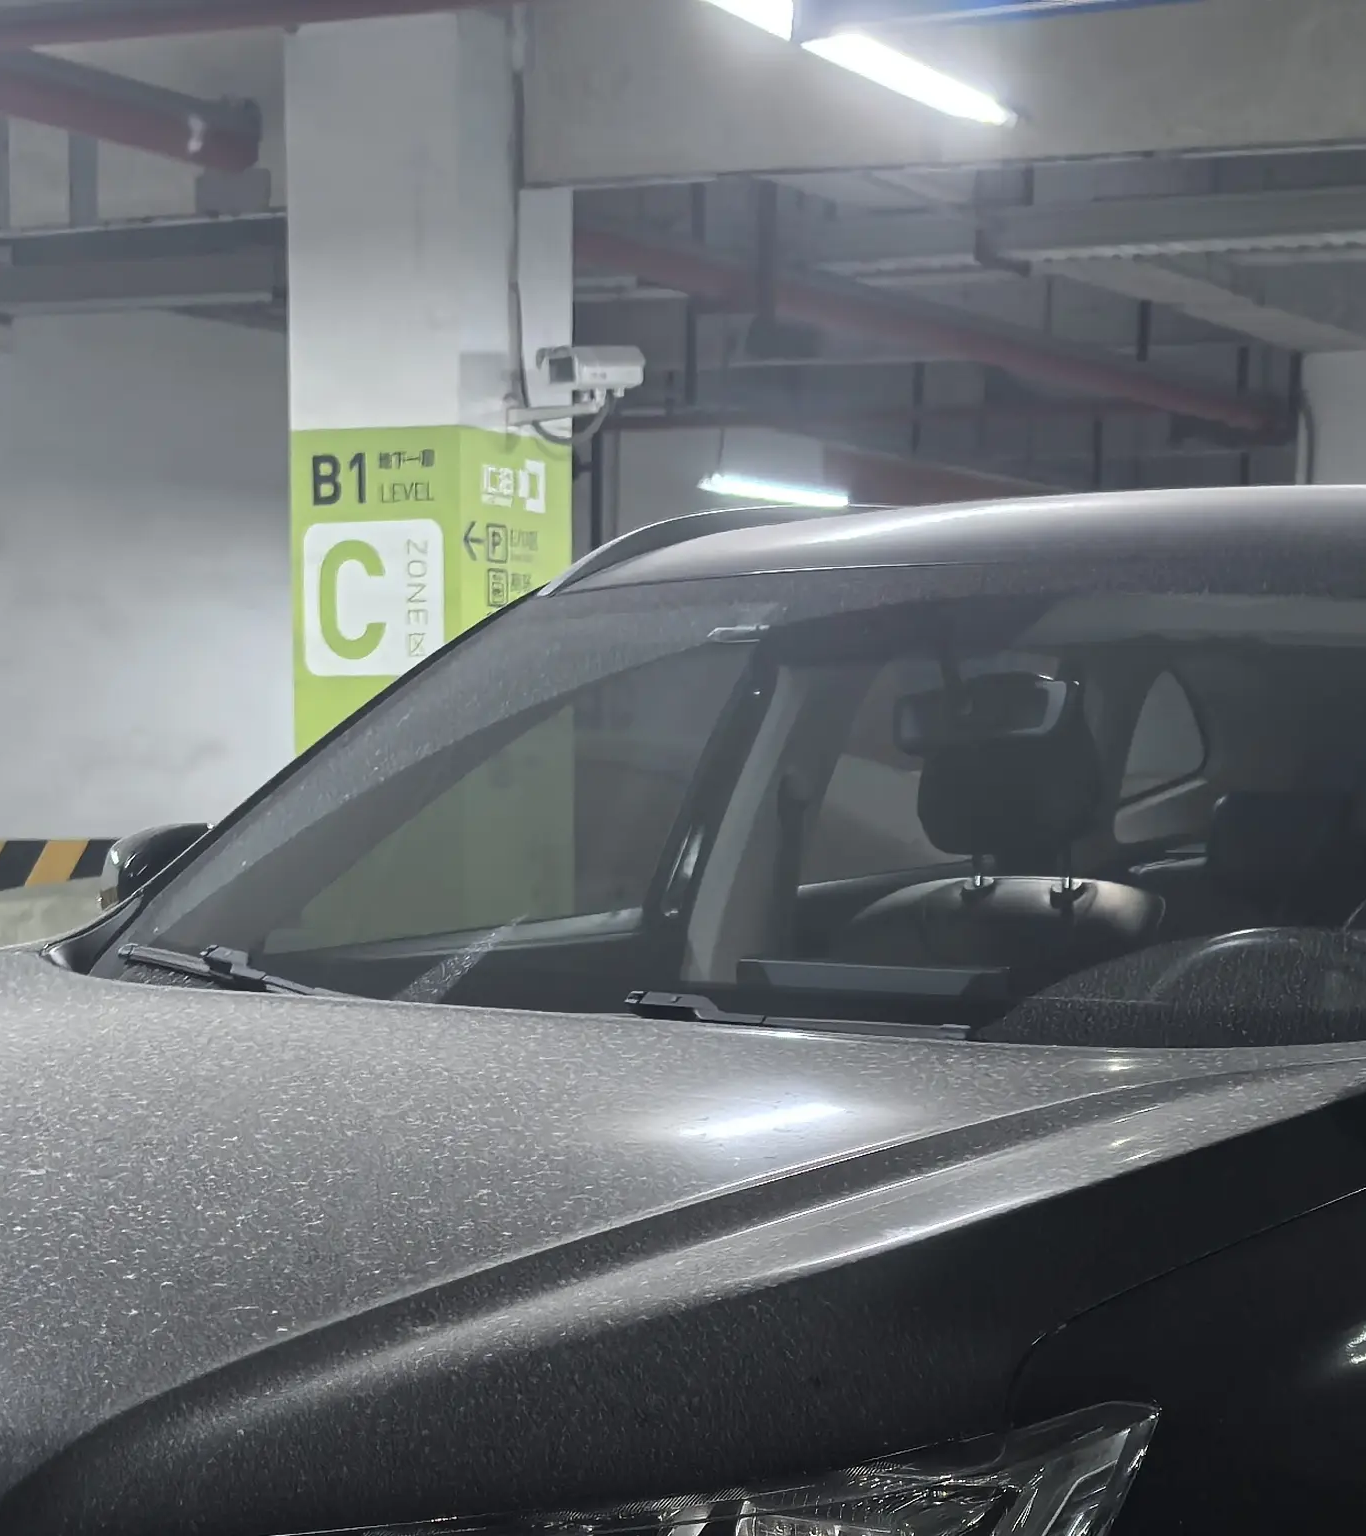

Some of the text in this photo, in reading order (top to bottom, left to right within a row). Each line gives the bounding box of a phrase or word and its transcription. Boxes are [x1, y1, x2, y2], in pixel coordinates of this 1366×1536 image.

[312, 452, 367, 506] B1
[381, 481, 435, 503] LEVEL
[320, 539, 387, 660] C
[406, 539, 429, 626] ZONE
